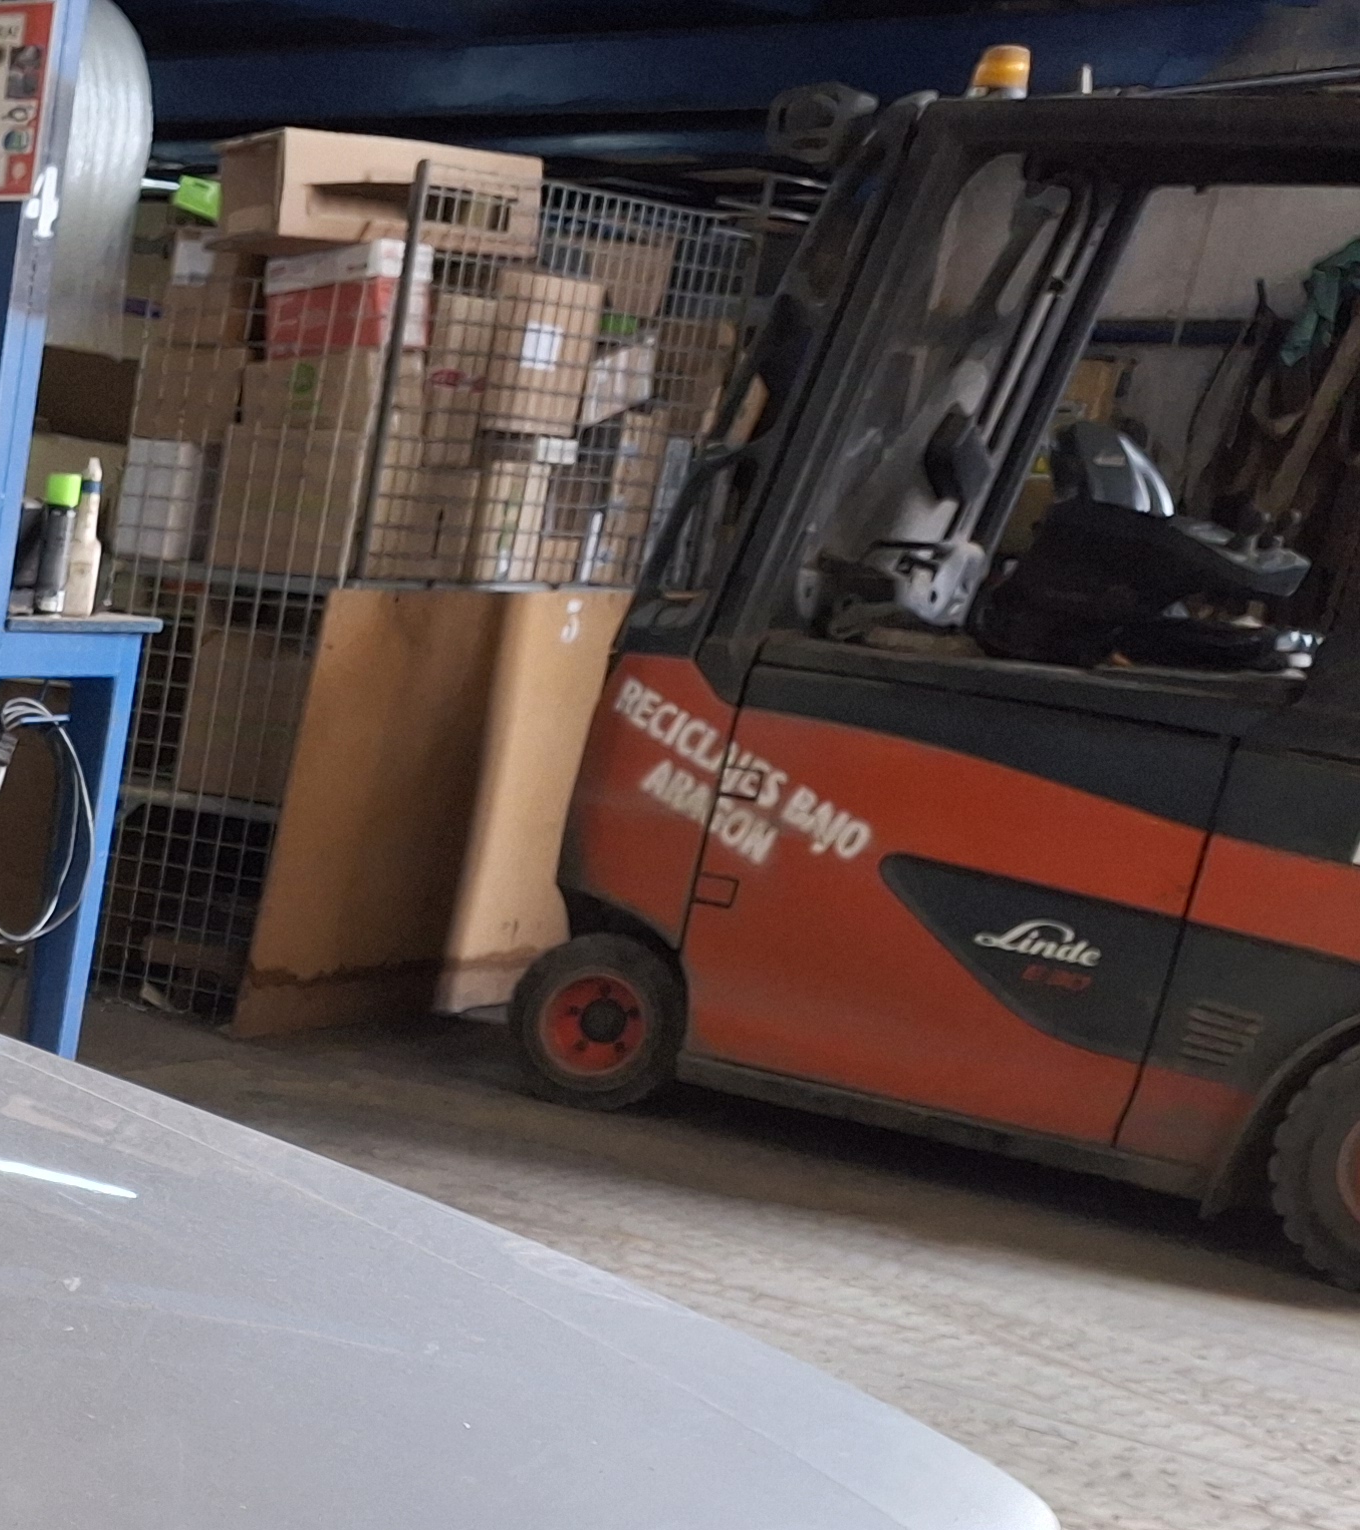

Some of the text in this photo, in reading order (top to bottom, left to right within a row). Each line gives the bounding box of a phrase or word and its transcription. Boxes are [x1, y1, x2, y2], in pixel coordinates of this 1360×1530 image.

[613, 675, 873, 860] RECICLAJES BAJO
[974, 918, 1102, 967] Linde
